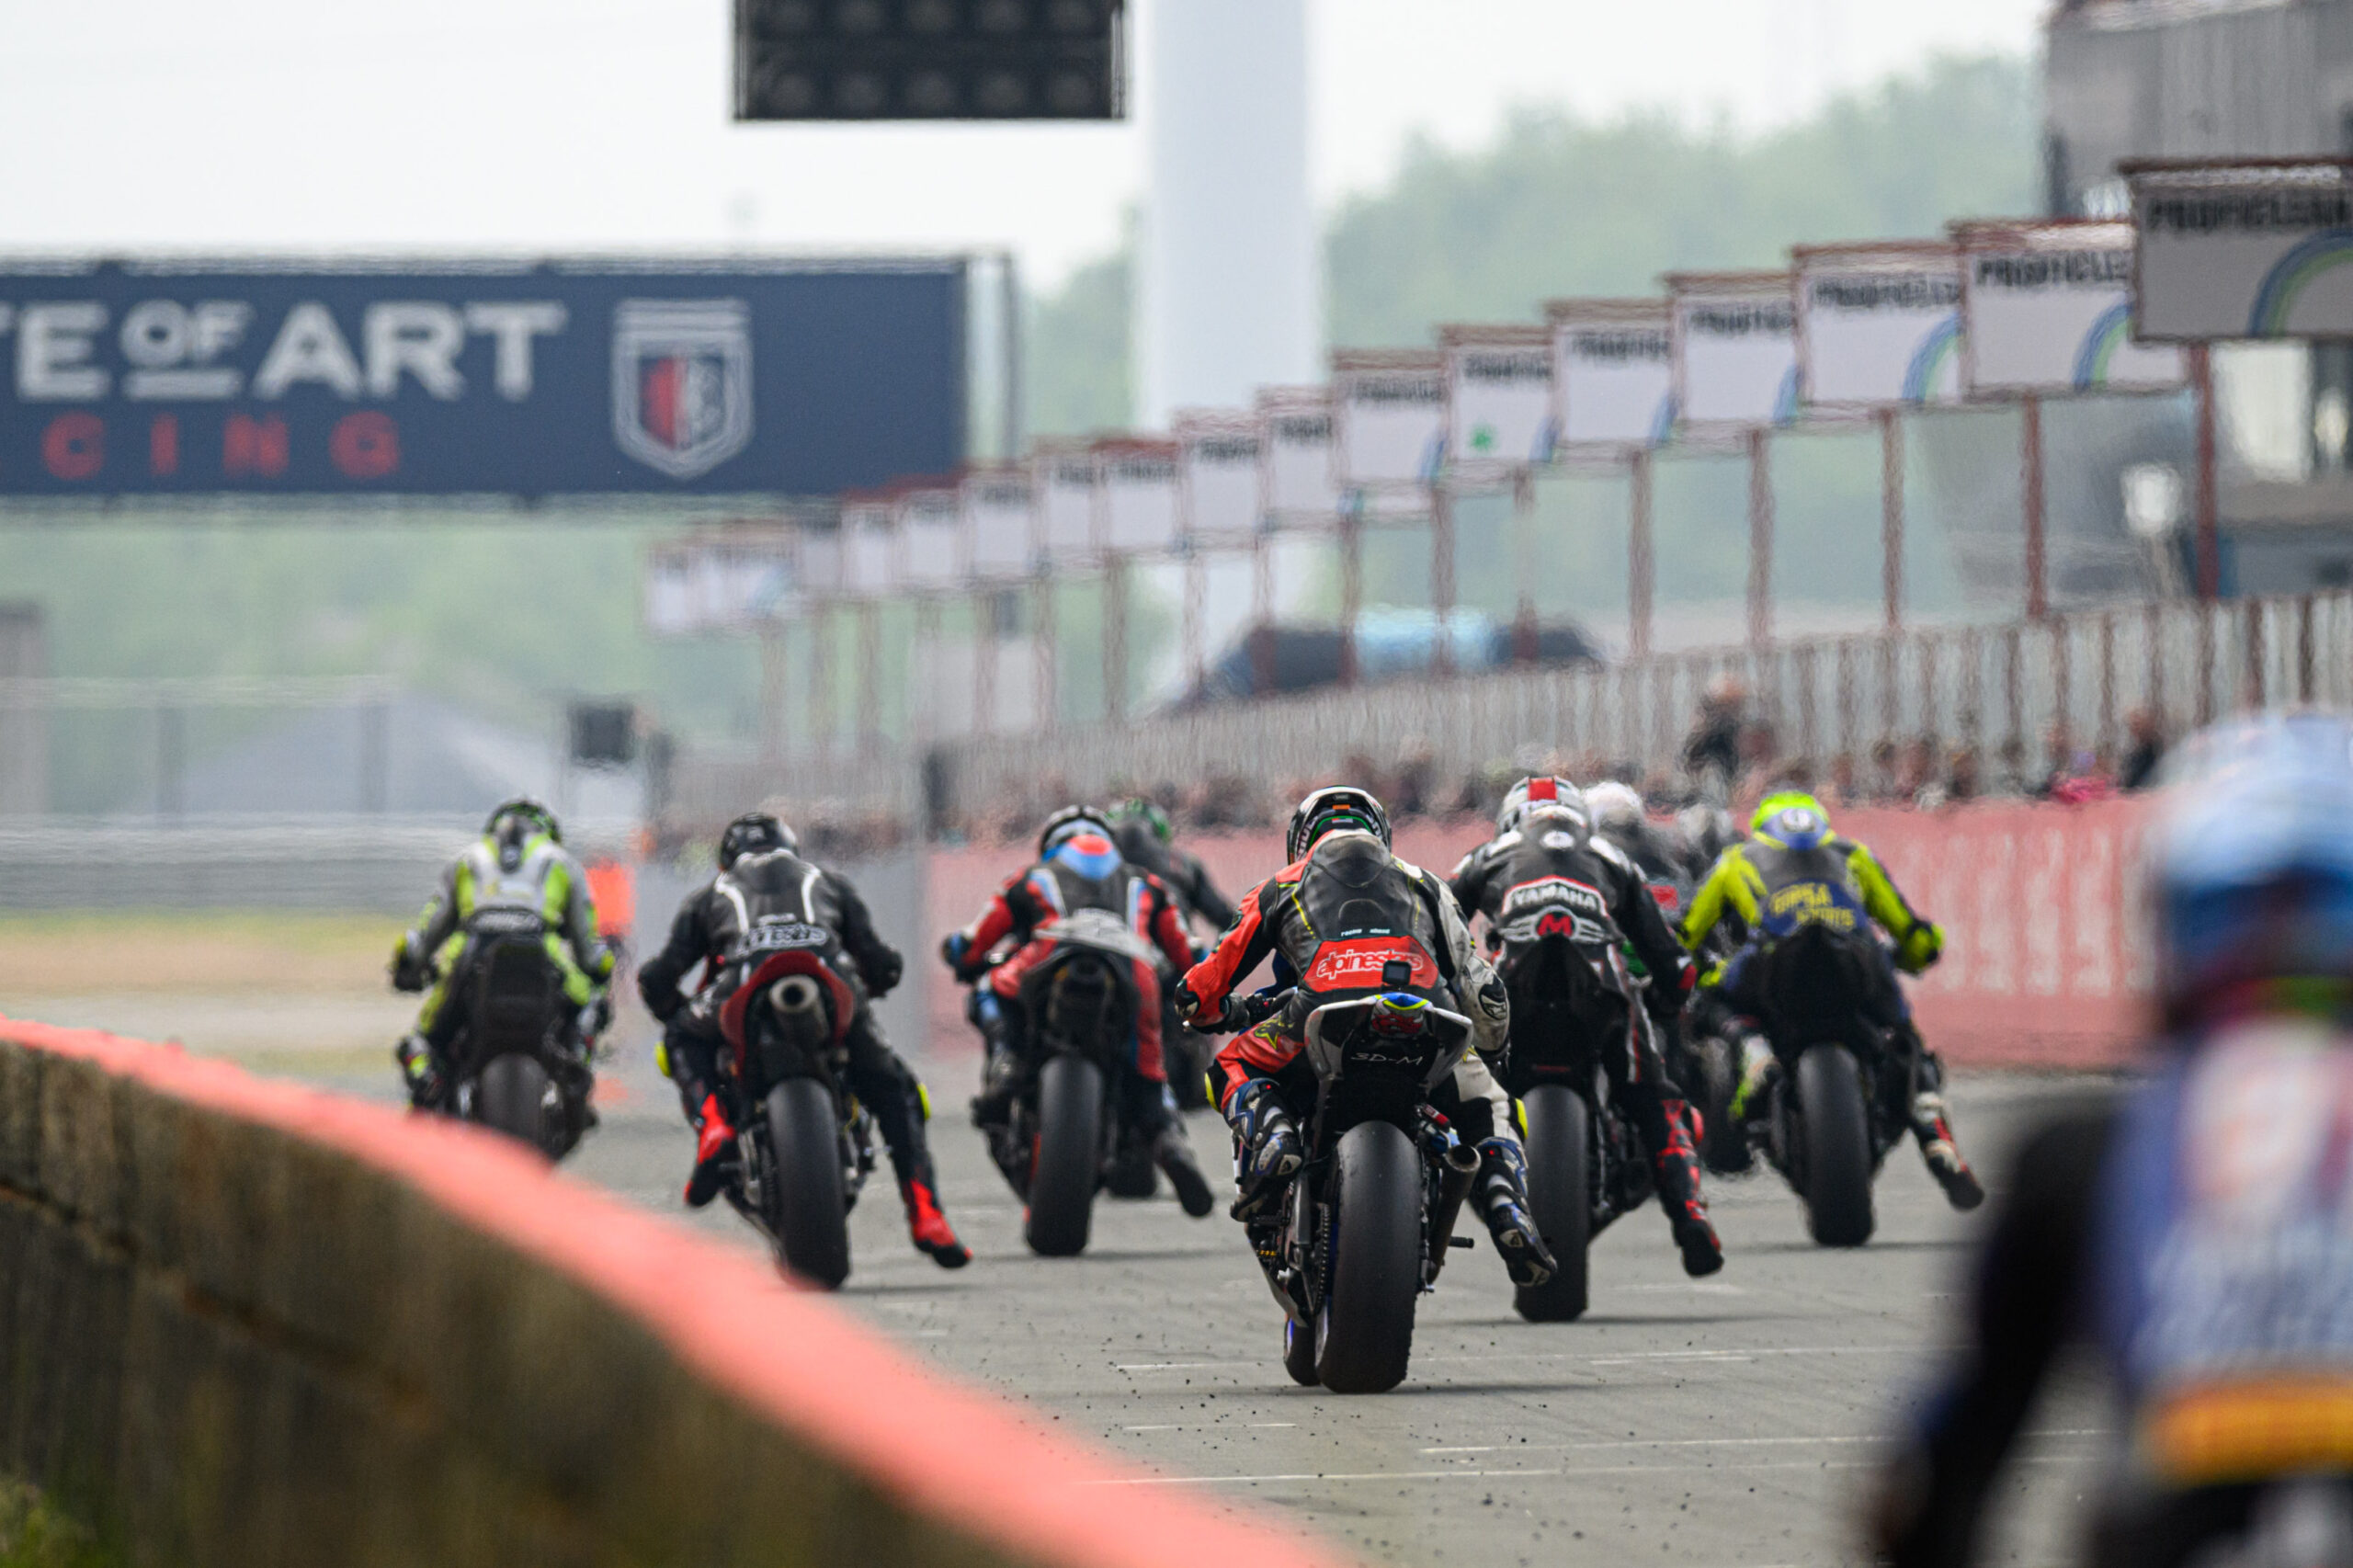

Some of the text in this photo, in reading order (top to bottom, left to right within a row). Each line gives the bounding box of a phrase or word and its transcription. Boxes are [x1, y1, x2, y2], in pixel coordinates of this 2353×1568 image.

[0, 299, 564, 402] E OF ART
[1512, 884, 1599, 912] YAMAHA
